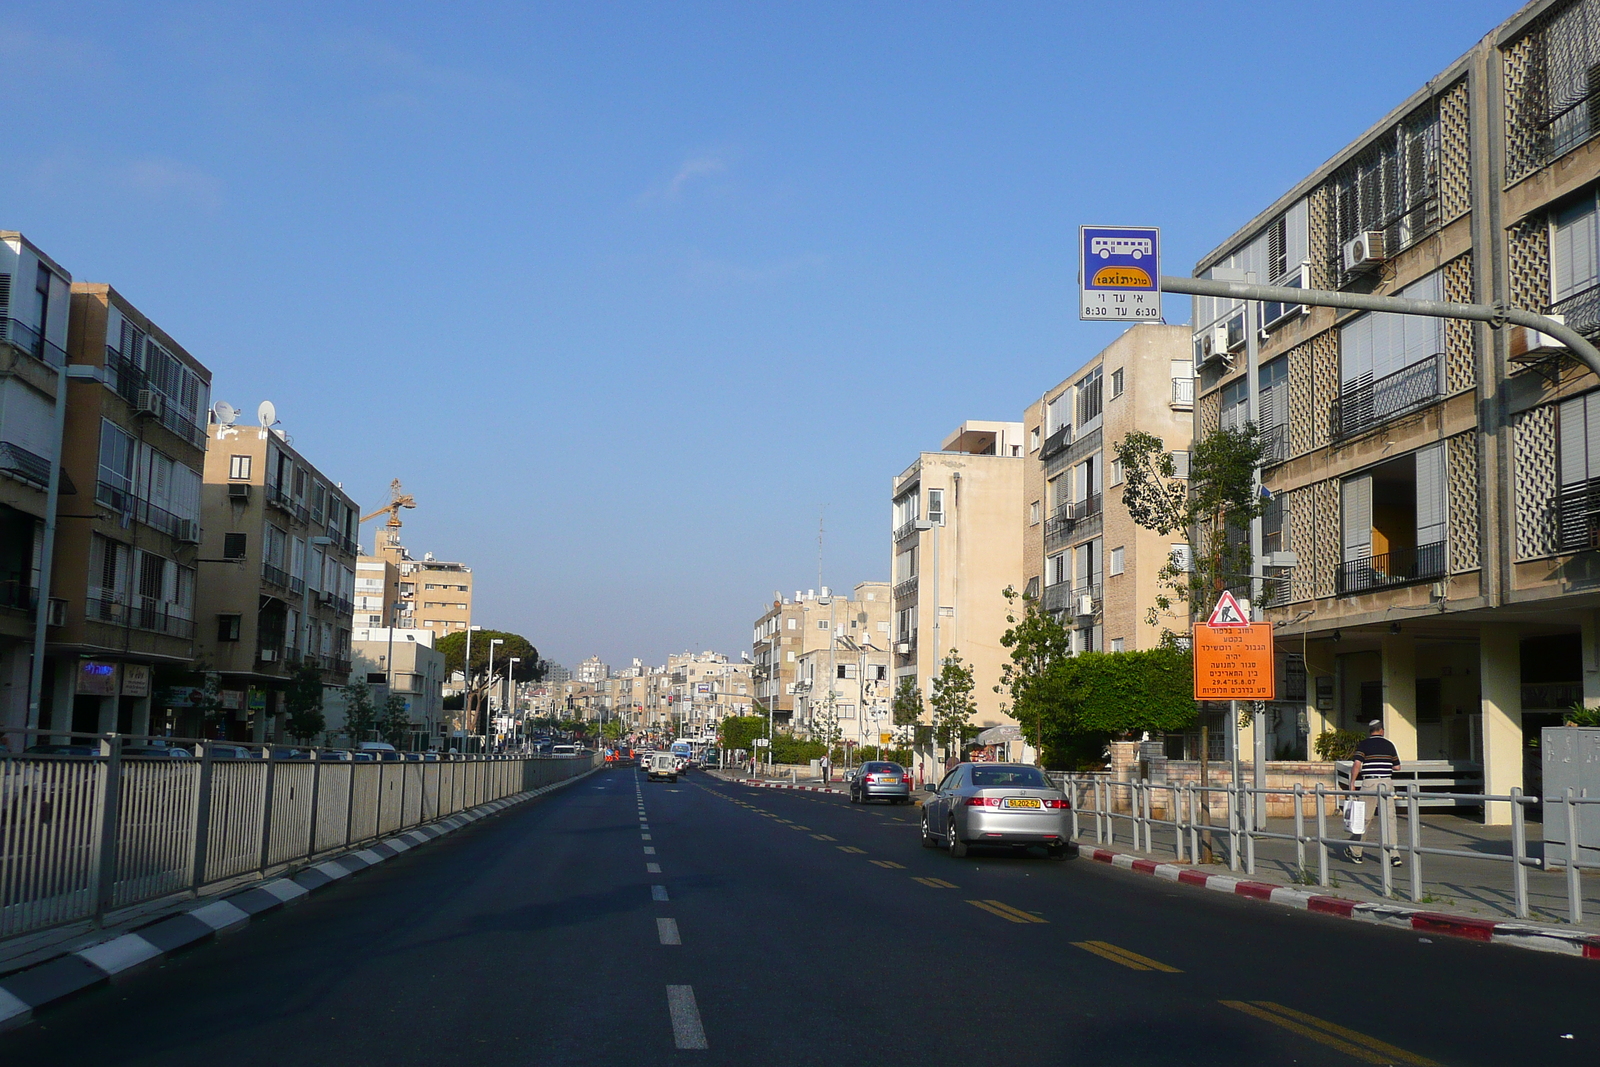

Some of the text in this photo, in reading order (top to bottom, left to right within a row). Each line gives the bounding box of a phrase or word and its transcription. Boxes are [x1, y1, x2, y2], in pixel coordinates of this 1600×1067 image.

[1097, 272, 1119, 284] taxi
[1120, 276, 1147, 285] מונית
[1113, 294, 1126, 303] עד
[1085, 307, 1157, 317] 6:30 עד 8:30
